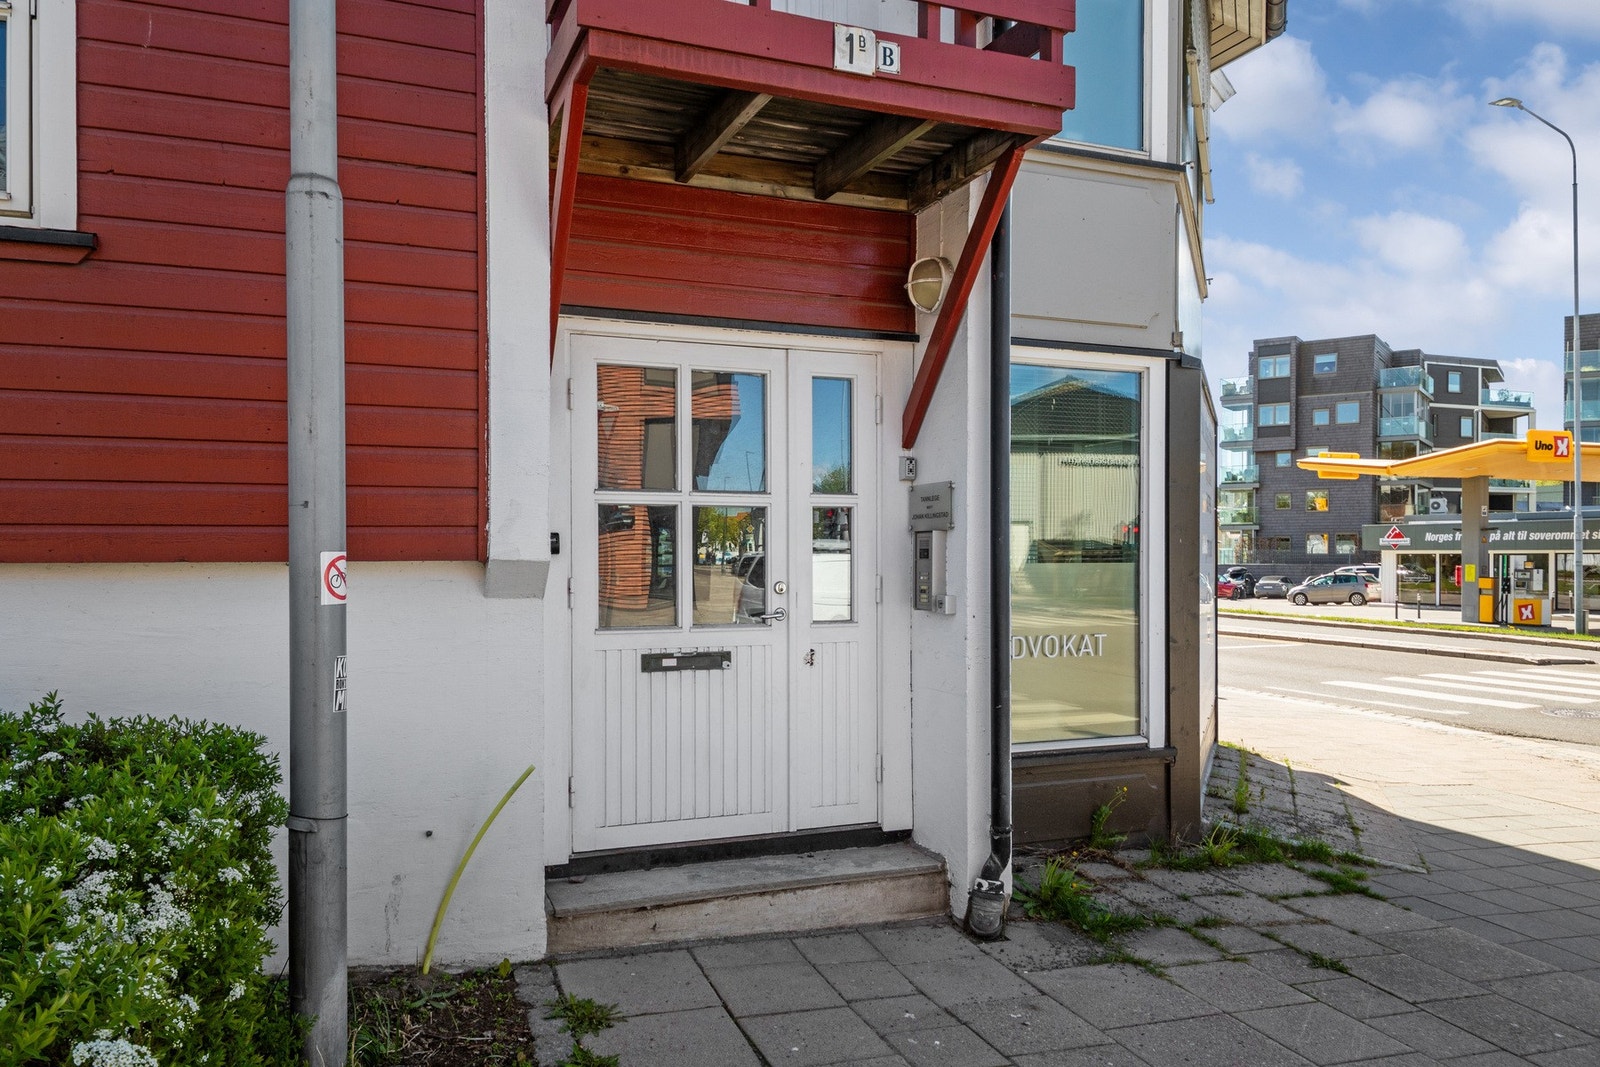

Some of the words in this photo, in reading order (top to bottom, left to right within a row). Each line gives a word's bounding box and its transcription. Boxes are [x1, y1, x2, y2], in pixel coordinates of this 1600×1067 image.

[882, 46, 894, 66] B
[1535, 440, 1553, 450] Uno
[1556, 439, 1568, 456] X
[1425, 532, 1453, 543] Norges
[1489, 530, 1501, 542] på
[1503, 531, 1516, 540] alt
[1517, 531, 1527, 540] til
[1521, 605, 1532, 619] X
[1011, 633, 1107, 659] DVOKAT
